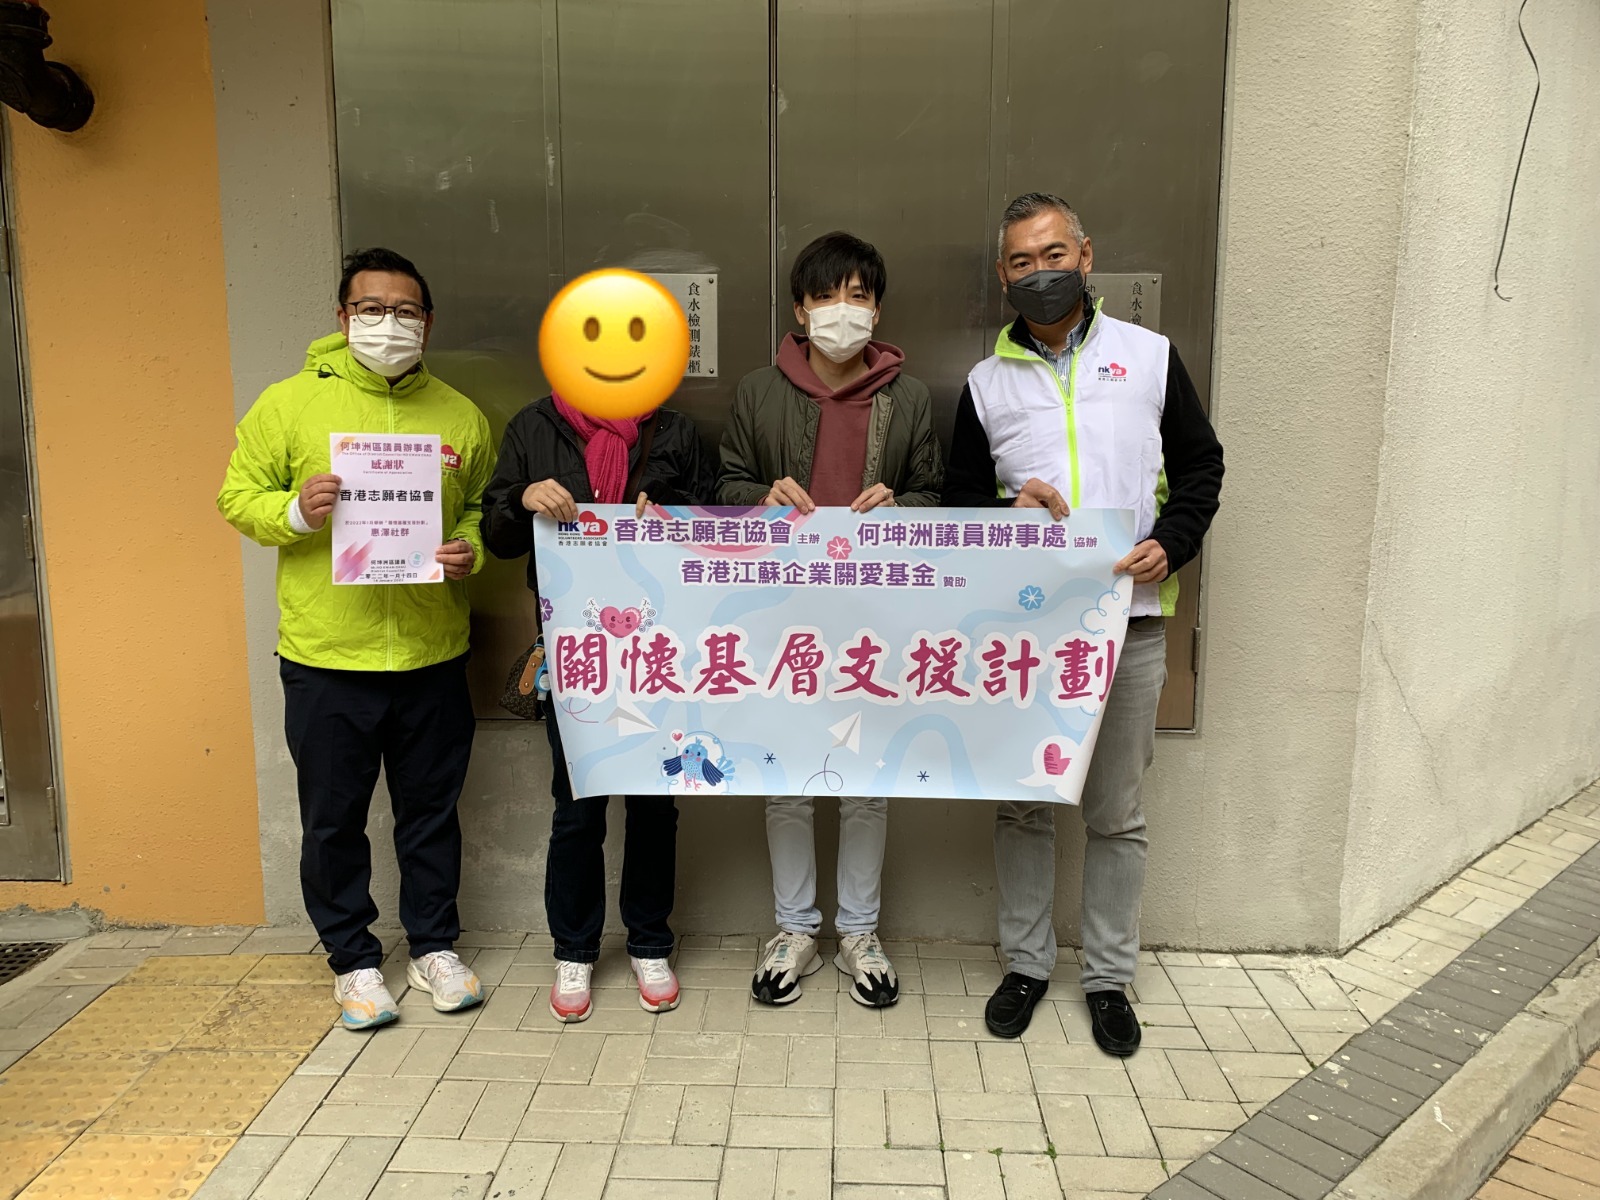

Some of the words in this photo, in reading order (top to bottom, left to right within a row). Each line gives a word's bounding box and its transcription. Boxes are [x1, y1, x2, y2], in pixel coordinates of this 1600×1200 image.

[340, 442, 433, 453] 何坤洲區議員辦事處
[371, 459, 404, 470] 感謝狀
[340, 489, 434, 502] 香港志願者協會
[614, 518, 792, 545] 香港志願者協會
[797, 533, 820, 545] 主辦
[856, 522, 1067, 548] 何坤洲議員辦事處
[1074, 536, 1098, 548] 協辦
[681, 560, 936, 586] 香港江蘇企業關愛基金
[556, 632, 1115, 702] 關懷基層支援計劃
